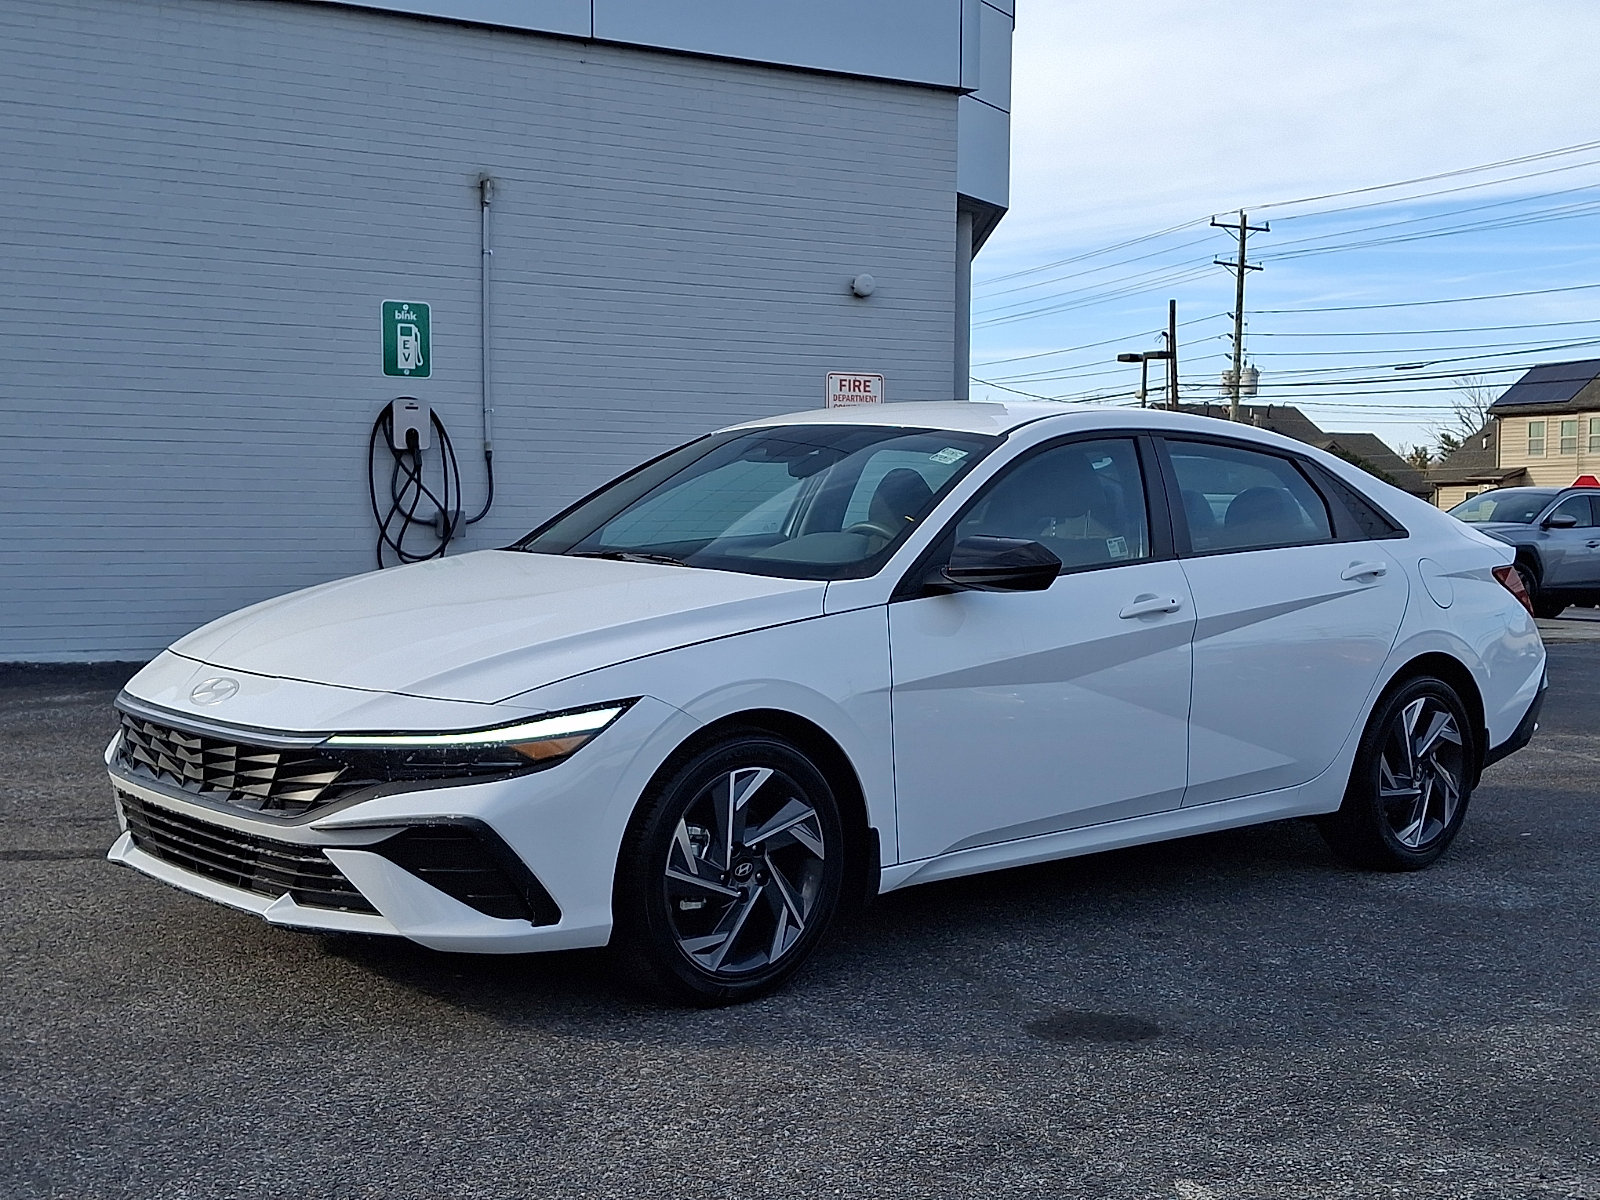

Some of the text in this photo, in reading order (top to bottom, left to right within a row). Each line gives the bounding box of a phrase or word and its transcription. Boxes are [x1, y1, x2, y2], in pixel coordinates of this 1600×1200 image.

[395, 310, 417, 320] blink
[402, 340, 410, 362] EV
[839, 379, 872, 393] FIRE
[833, 394, 878, 403] DEPARTMENT
